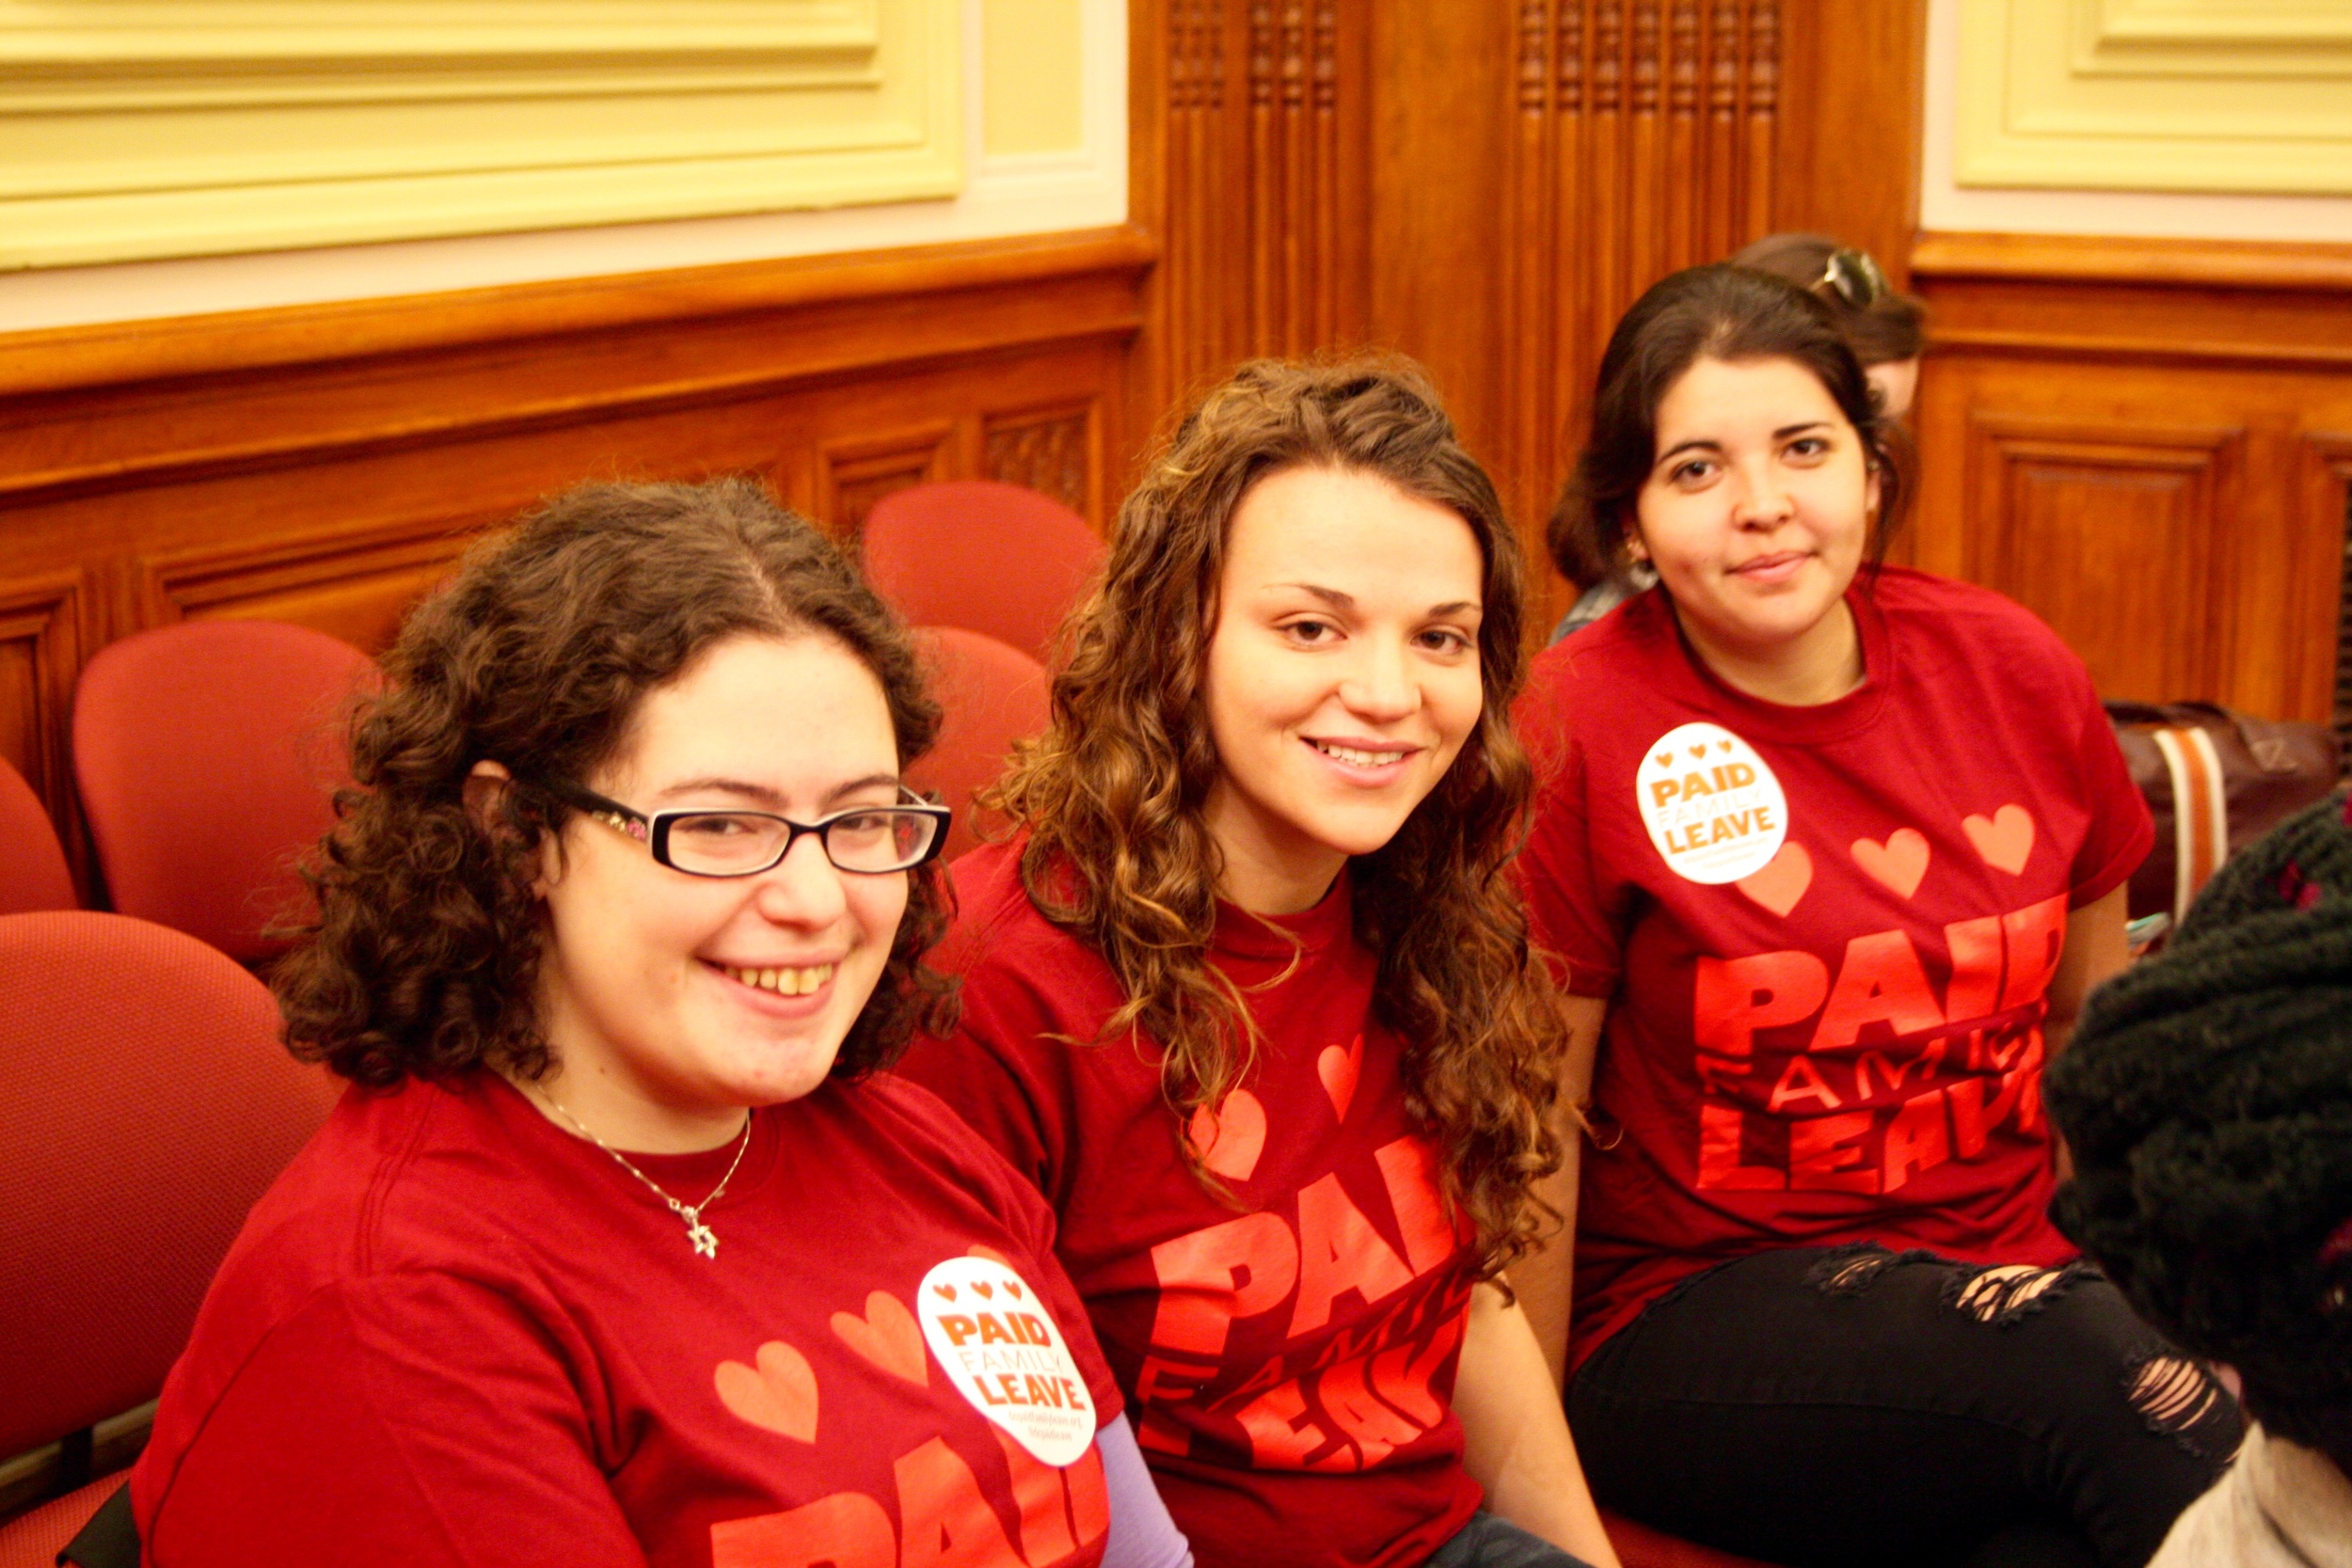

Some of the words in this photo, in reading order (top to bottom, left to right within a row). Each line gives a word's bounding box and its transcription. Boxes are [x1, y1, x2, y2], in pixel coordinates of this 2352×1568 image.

[1650, 762, 1756, 808] PAID
[1664, 806, 1775, 855] LEAVE
[1151, 1134, 1476, 1354] PAI
[936, 1311, 1051, 1348] PAID
[958, 1349, 1064, 1374] FAMILY
[973, 1372, 1087, 1411] LEAVE
